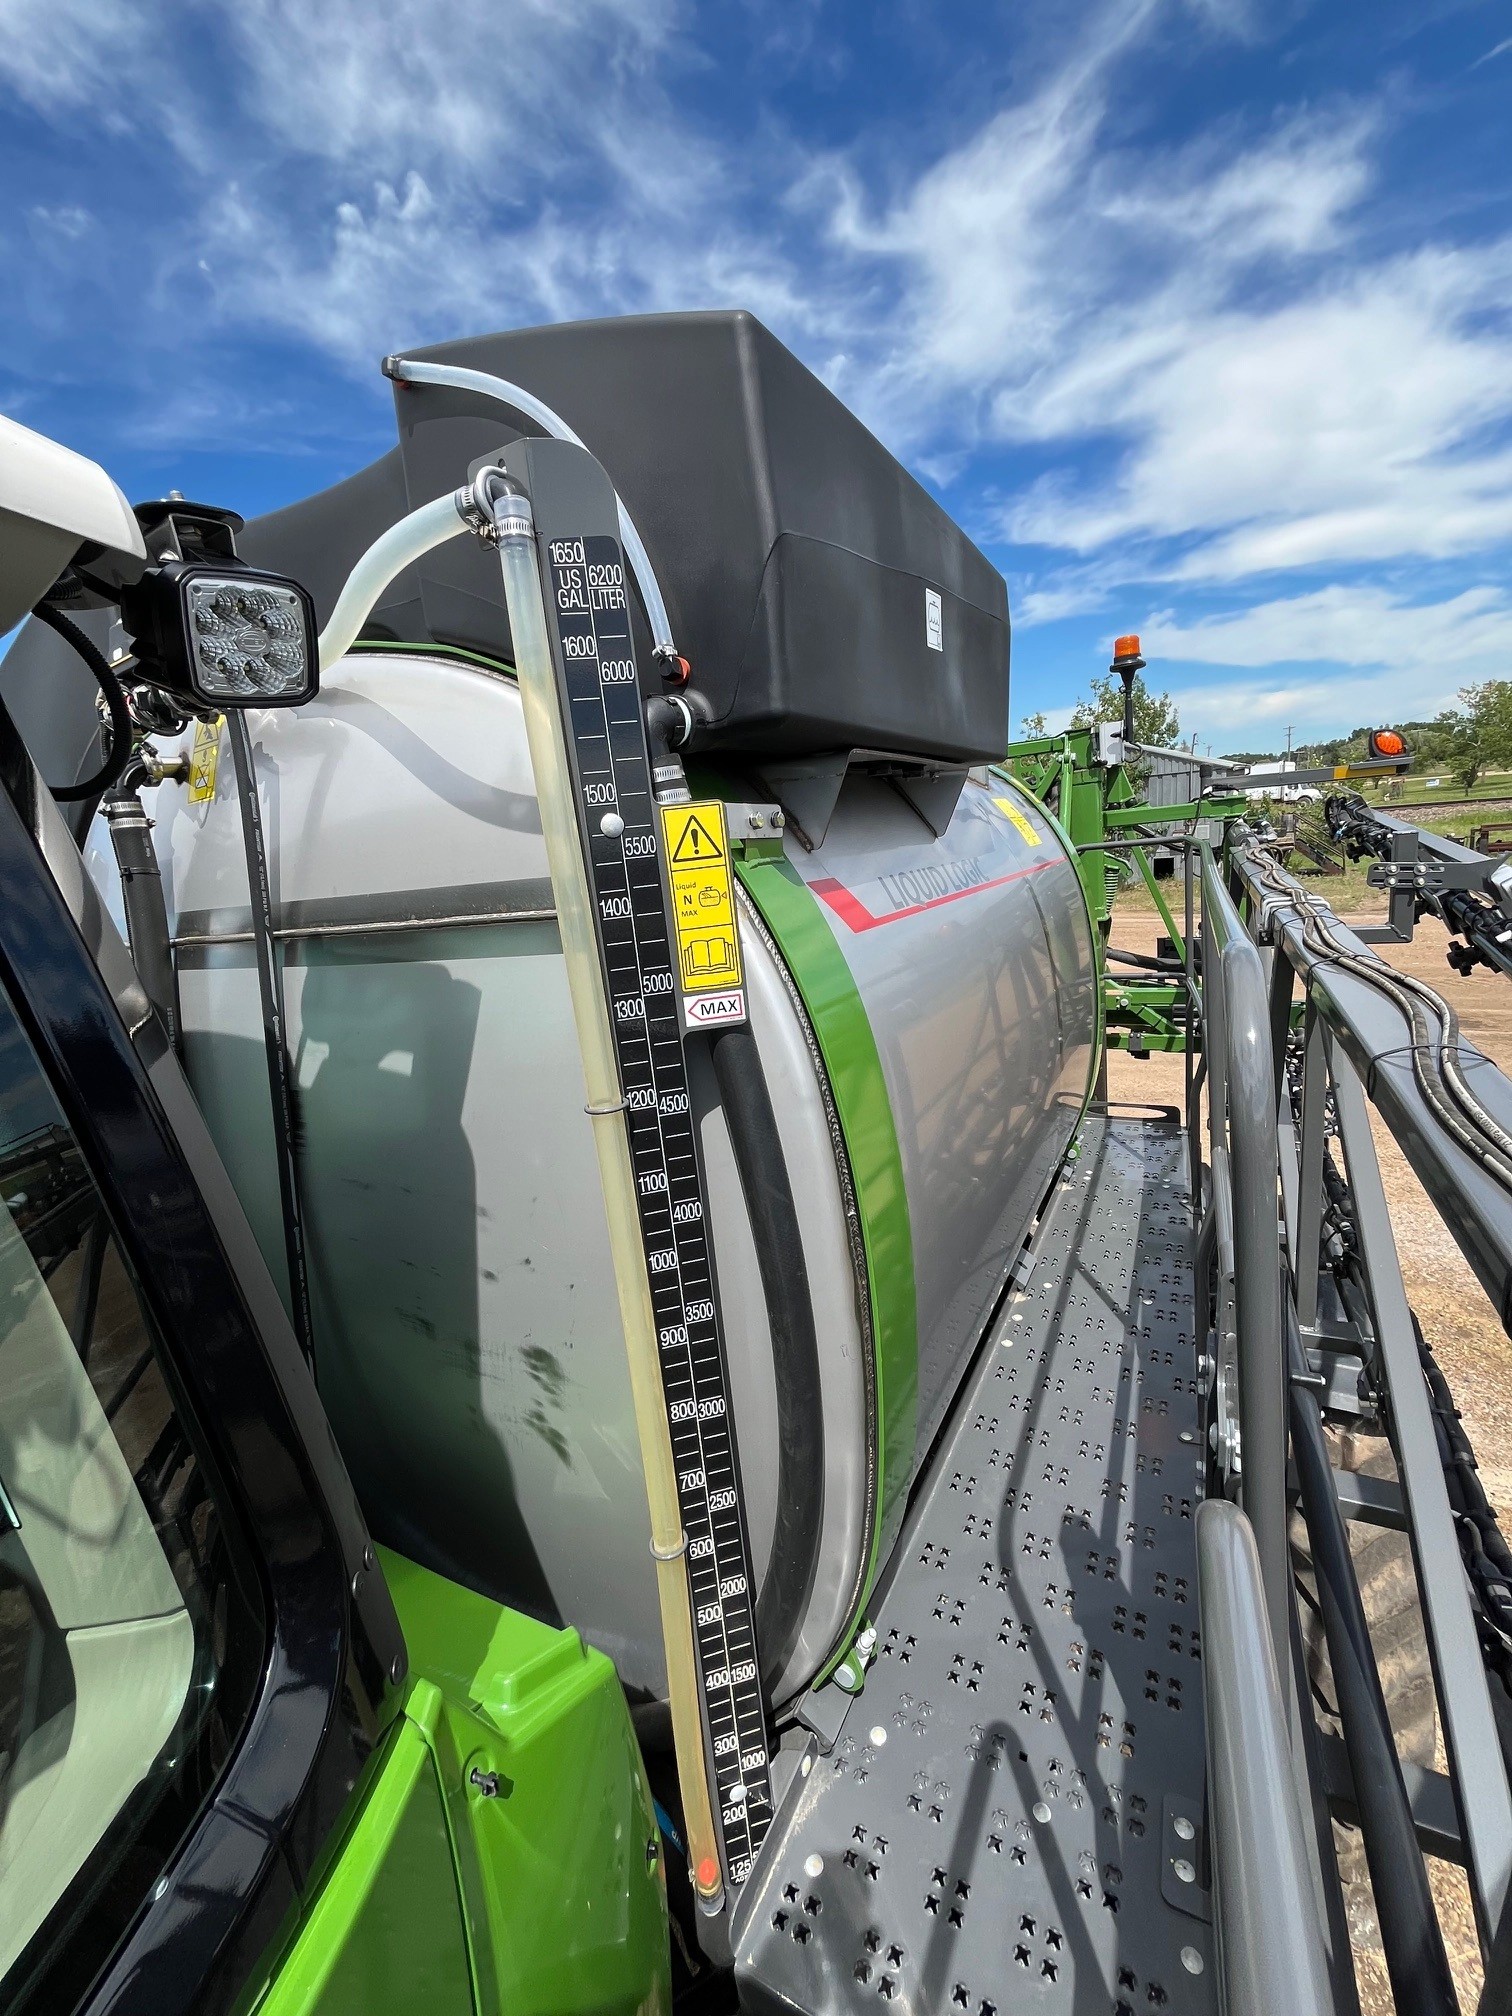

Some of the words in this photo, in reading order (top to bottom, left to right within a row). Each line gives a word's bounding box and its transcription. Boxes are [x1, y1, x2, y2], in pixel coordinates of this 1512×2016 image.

[550, 542, 583, 563] 1650
[559, 569, 581, 589] US
[589, 565, 622, 585] 6200
[558, 589, 589, 608] GAL
[592, 589, 626, 610] LITER
[562, 636, 595, 656] 1600
[602, 660, 634, 681] 6000
[583, 783, 615, 803] 1500
[626, 835, 656, 855] 5500
[676, 882, 696, 890] Liquid
[600, 897, 630, 917] 1400
[684, 895, 692, 905] N
[644, 973, 673, 993] 5000
[614, 999, 644, 1018] 1300
[701, 999, 737, 1015] MAX
[627, 1089, 655, 1109] 1200
[660, 1094, 688, 1113] 4500
[638, 1173, 667, 1193] 1100
[674, 1202, 702, 1221] 4000
[649, 1251, 676, 1270] 1000
[686, 1302, 713, 1322] 3500
[661, 1326, 686, 1347] 900
[671, 1401, 696, 1420] 800
[698, 1399, 726, 1418] 3000
[679, 1470, 704, 1490] 700
[710, 1490, 736, 1510] 2500
[689, 1539, 713, 1558] 600
[720, 1577, 746, 1597] 2000
[698, 1606, 721, 1624] 500
[706, 1670, 728, 1689] 400
[731, 1664, 755, 1682] 1500
[714, 1735, 737, 1754] 300
[742, 1751, 765, 1769] 1000
[723, 1805, 745, 1824] 200
[730, 1859, 751, 1877] 125
